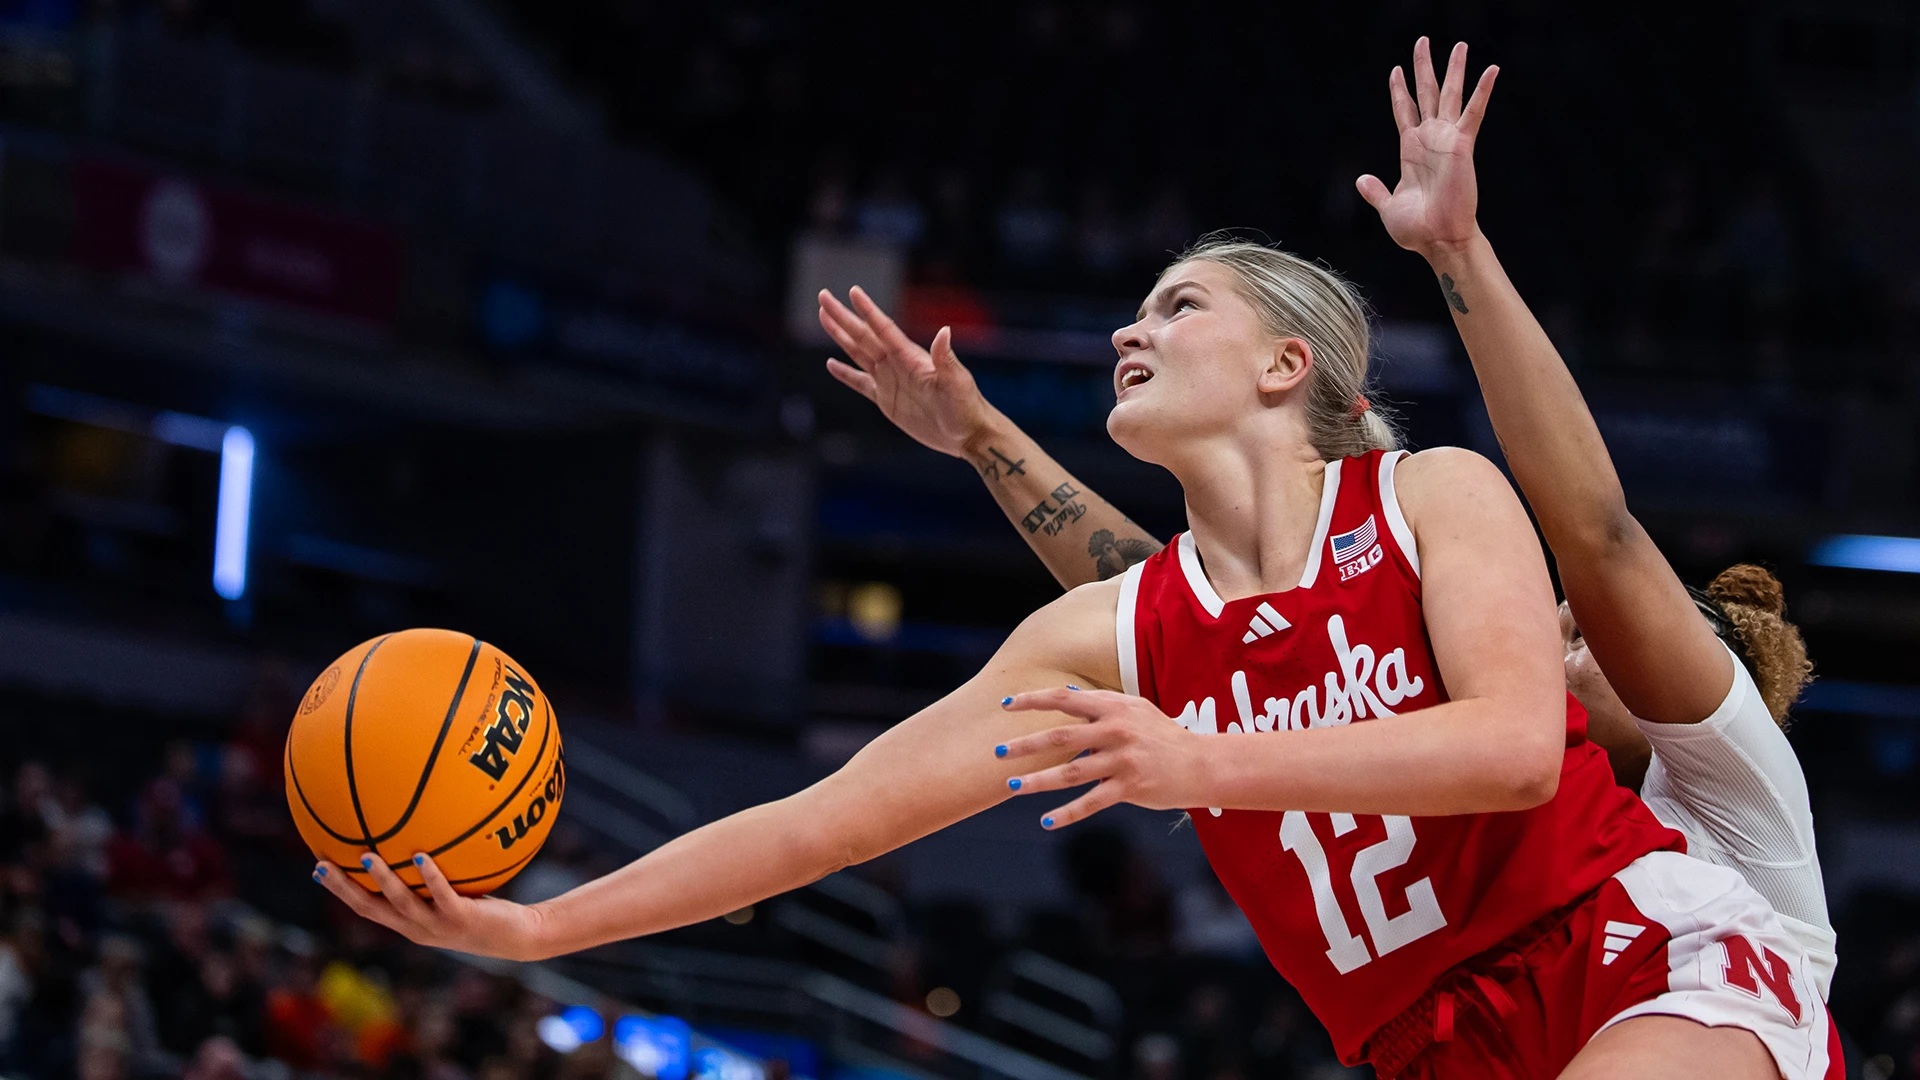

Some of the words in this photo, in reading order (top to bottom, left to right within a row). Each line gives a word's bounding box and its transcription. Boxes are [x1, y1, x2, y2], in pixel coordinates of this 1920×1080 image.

[1021, 500, 1057, 534] ME
[1051, 482, 1080, 506] IN
[468, 663, 536, 783] NCAA
[1279, 810, 1448, 975] 12
[1719, 933, 1803, 1027] N
